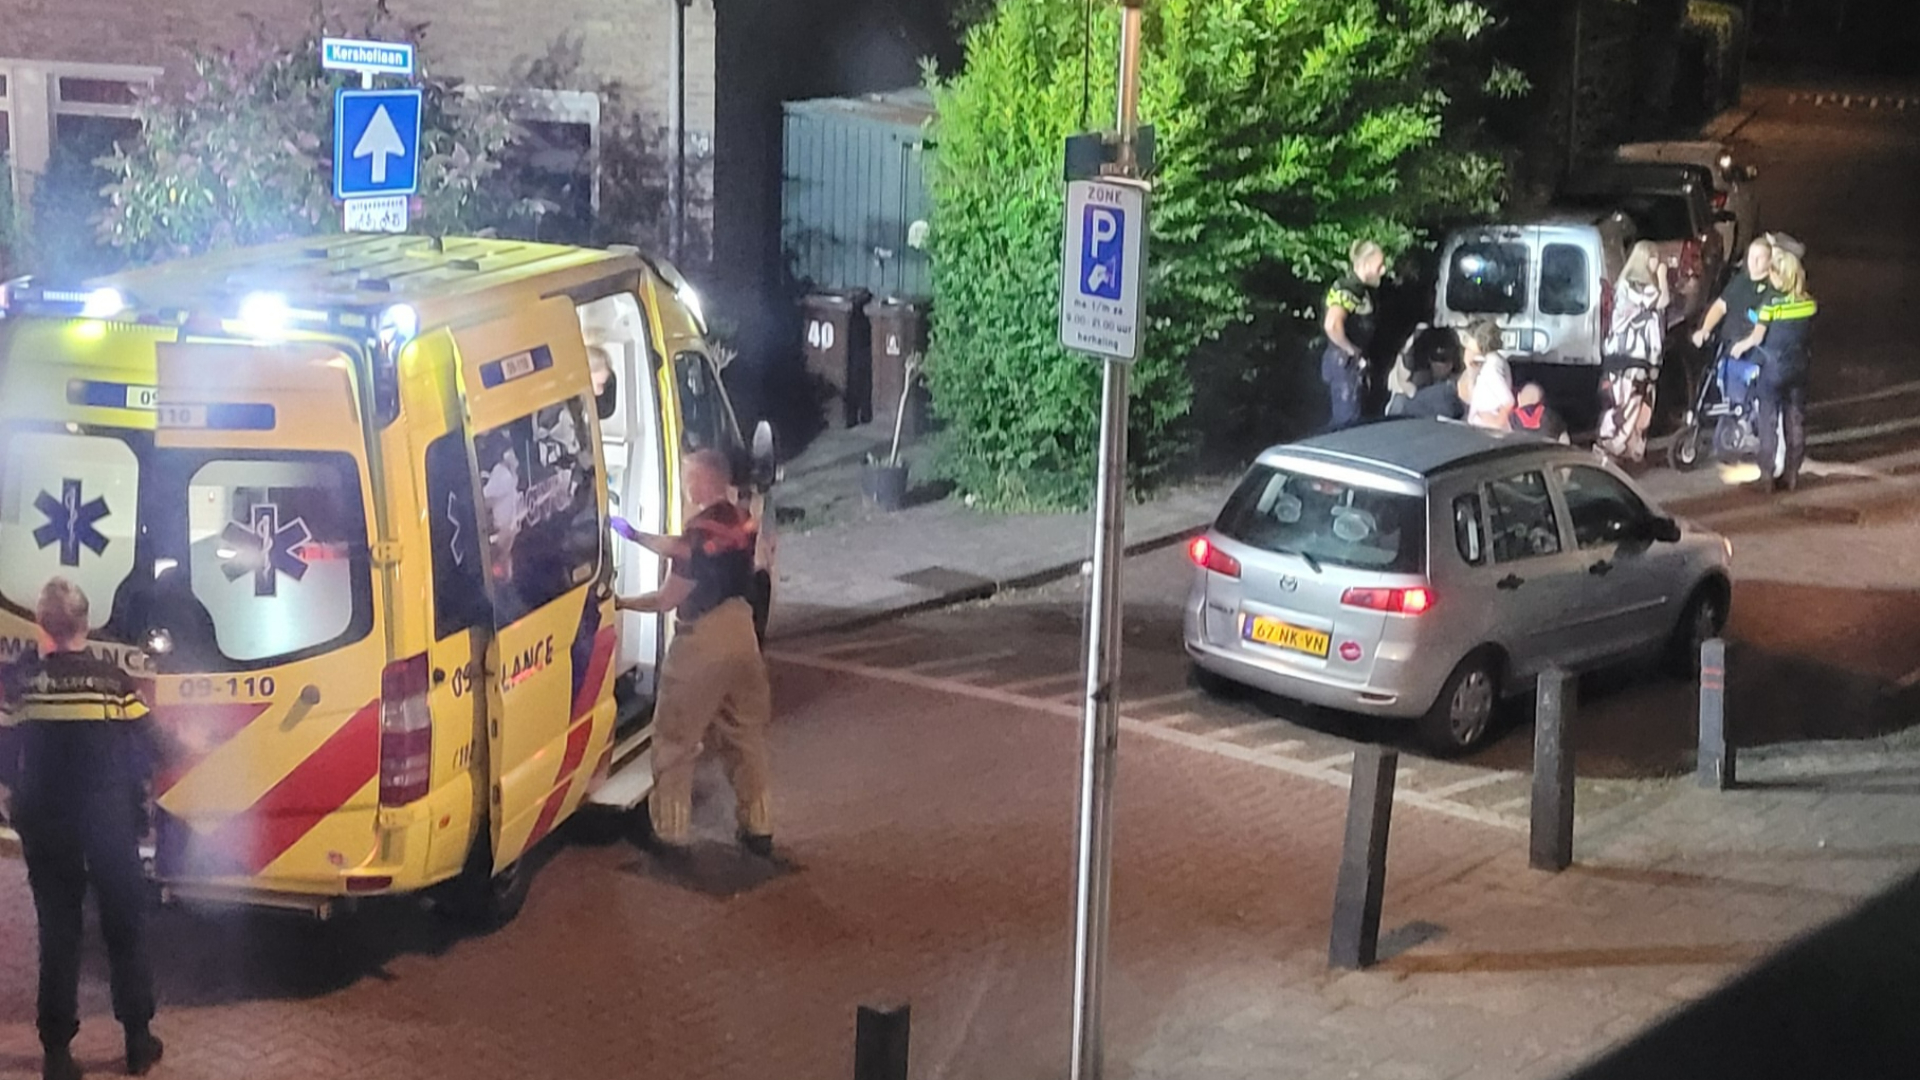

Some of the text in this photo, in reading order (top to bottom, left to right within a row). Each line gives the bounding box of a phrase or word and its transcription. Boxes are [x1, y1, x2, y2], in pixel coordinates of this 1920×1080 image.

[1087, 186, 1122, 204] ZONE
[1091, 209, 1117, 259] P
[807, 320, 835, 349] 40
[1116, 324, 1132, 334] uur
[1077, 331, 1119, 352] herhaling
[179, 676, 275, 697] 09-110
